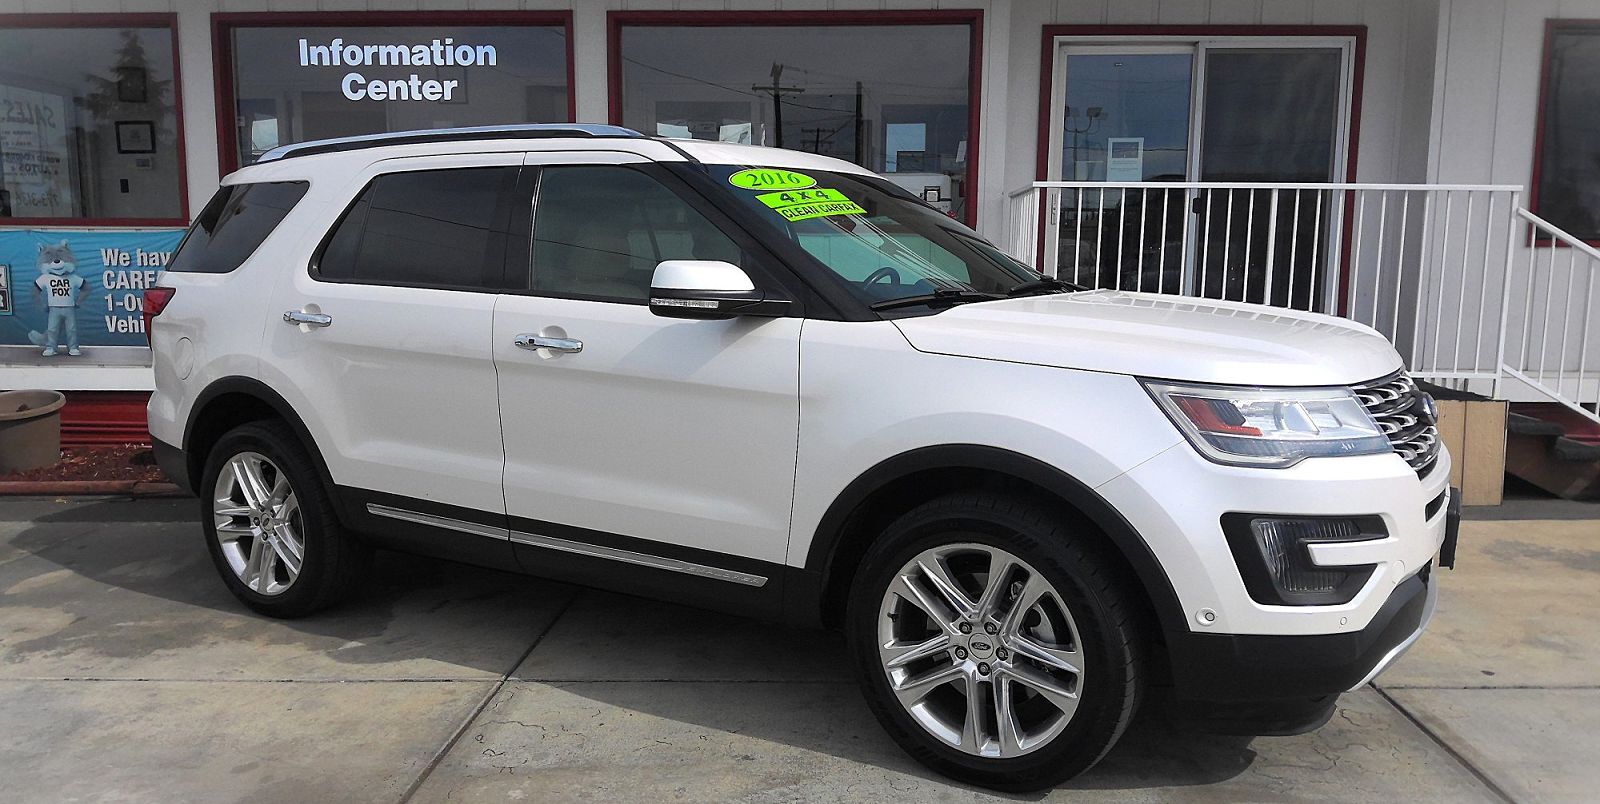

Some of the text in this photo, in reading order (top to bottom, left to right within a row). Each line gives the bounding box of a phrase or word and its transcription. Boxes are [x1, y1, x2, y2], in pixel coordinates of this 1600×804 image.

[299, 38, 497, 66] Information
[341, 72, 458, 101] Center
[746, 172, 801, 187] 2016
[781, 202, 860, 218] CLEAN CARFAX
[101, 248, 130, 267] We
[50, 279, 70, 288] CAR
[103, 270, 158, 289] CARF
[52, 288, 70, 297] FOX
